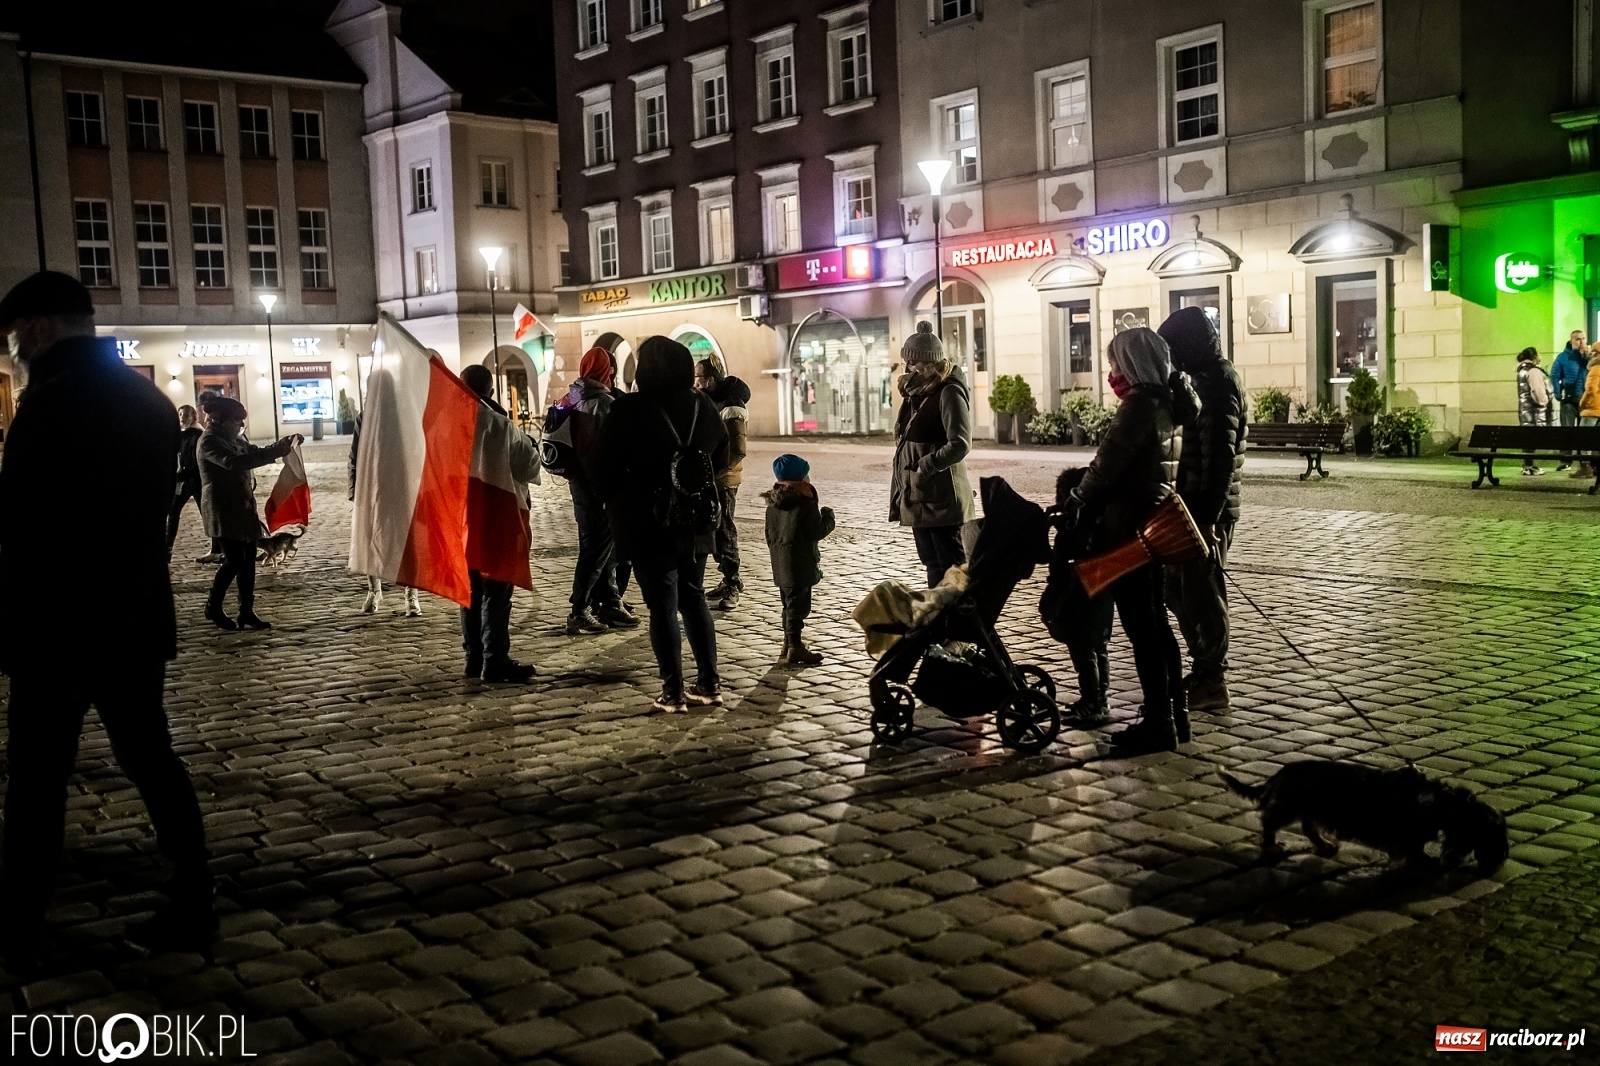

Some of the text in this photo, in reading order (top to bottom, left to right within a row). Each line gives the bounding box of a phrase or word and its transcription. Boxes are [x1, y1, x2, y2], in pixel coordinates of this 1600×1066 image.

[952, 219, 1167, 267] RESTAURACJA SHIRO
[581, 287, 627, 303] TABAC
[649, 274, 725, 303] KANTOR
